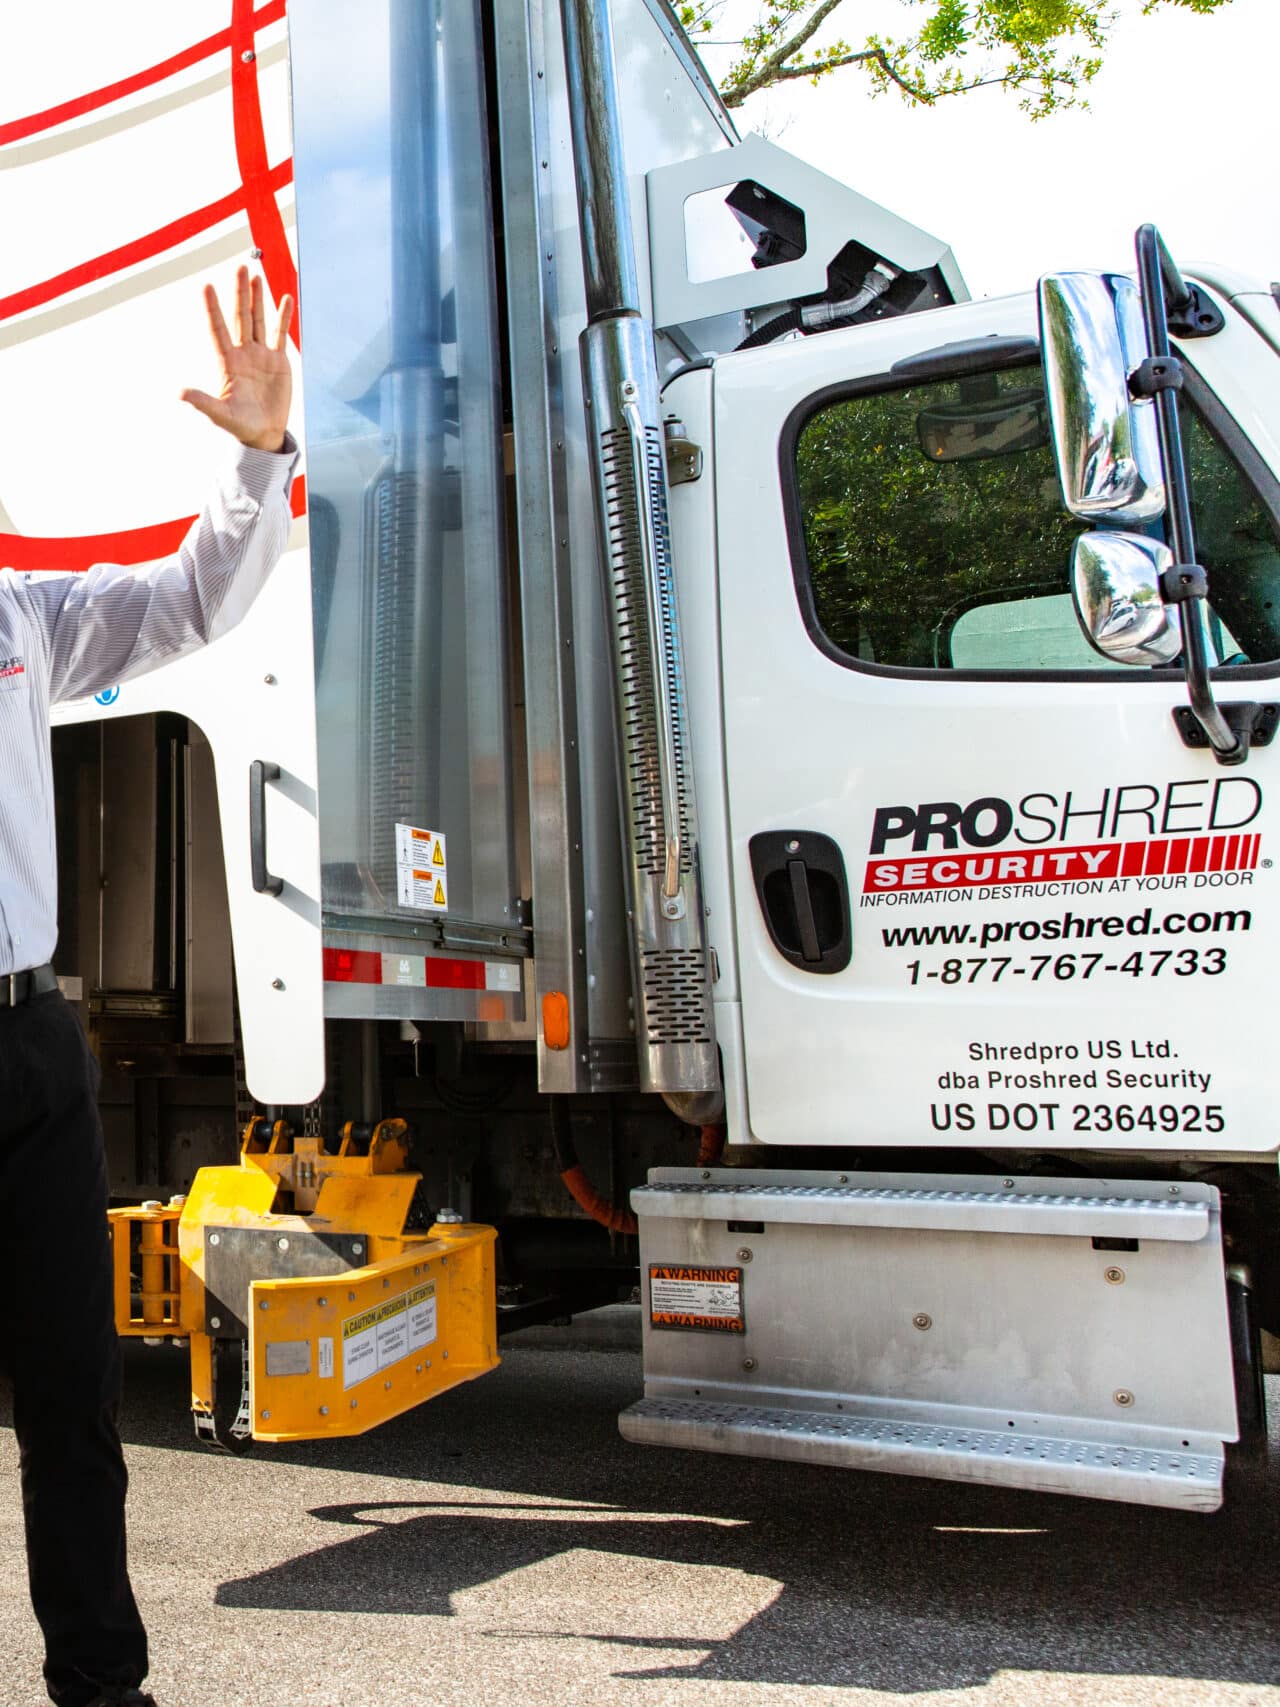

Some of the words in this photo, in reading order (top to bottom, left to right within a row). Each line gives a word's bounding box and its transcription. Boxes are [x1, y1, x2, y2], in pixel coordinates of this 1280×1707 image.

[869, 777, 1263, 855] PROSHRED
[873, 850, 1111, 887] SECURITY
[860, 888, 973, 908] INFORMATION
[978, 879, 1103, 901] DESTRUCTION
[1109, 878, 1131, 893] AT
[1135, 875, 1188, 892] YOUR
[1194, 871, 1253, 888] DOOR
[881, 908, 1252, 949] www.proshred.com
[906, 947, 1227, 985] 1-877-767-4733
[969, 1041, 1079, 1064] Shredpro
[1087, 1039, 1121, 1059] US
[1131, 1039, 1179, 1059] Ltd.
[938, 1071, 979, 1089] dba
[988, 1070, 1097, 1089] Proshred
[1106, 1069, 1212, 1093] Security
[930, 1103, 976, 1131] US
[988, 1103, 1059, 1131] DOT
[1072, 1104, 1225, 1133] 2364925
[669, 1268, 737, 1282] WARNING
[349, 1311, 376, 1333] CAUTION
[670, 1314, 739, 1330] WARNING
